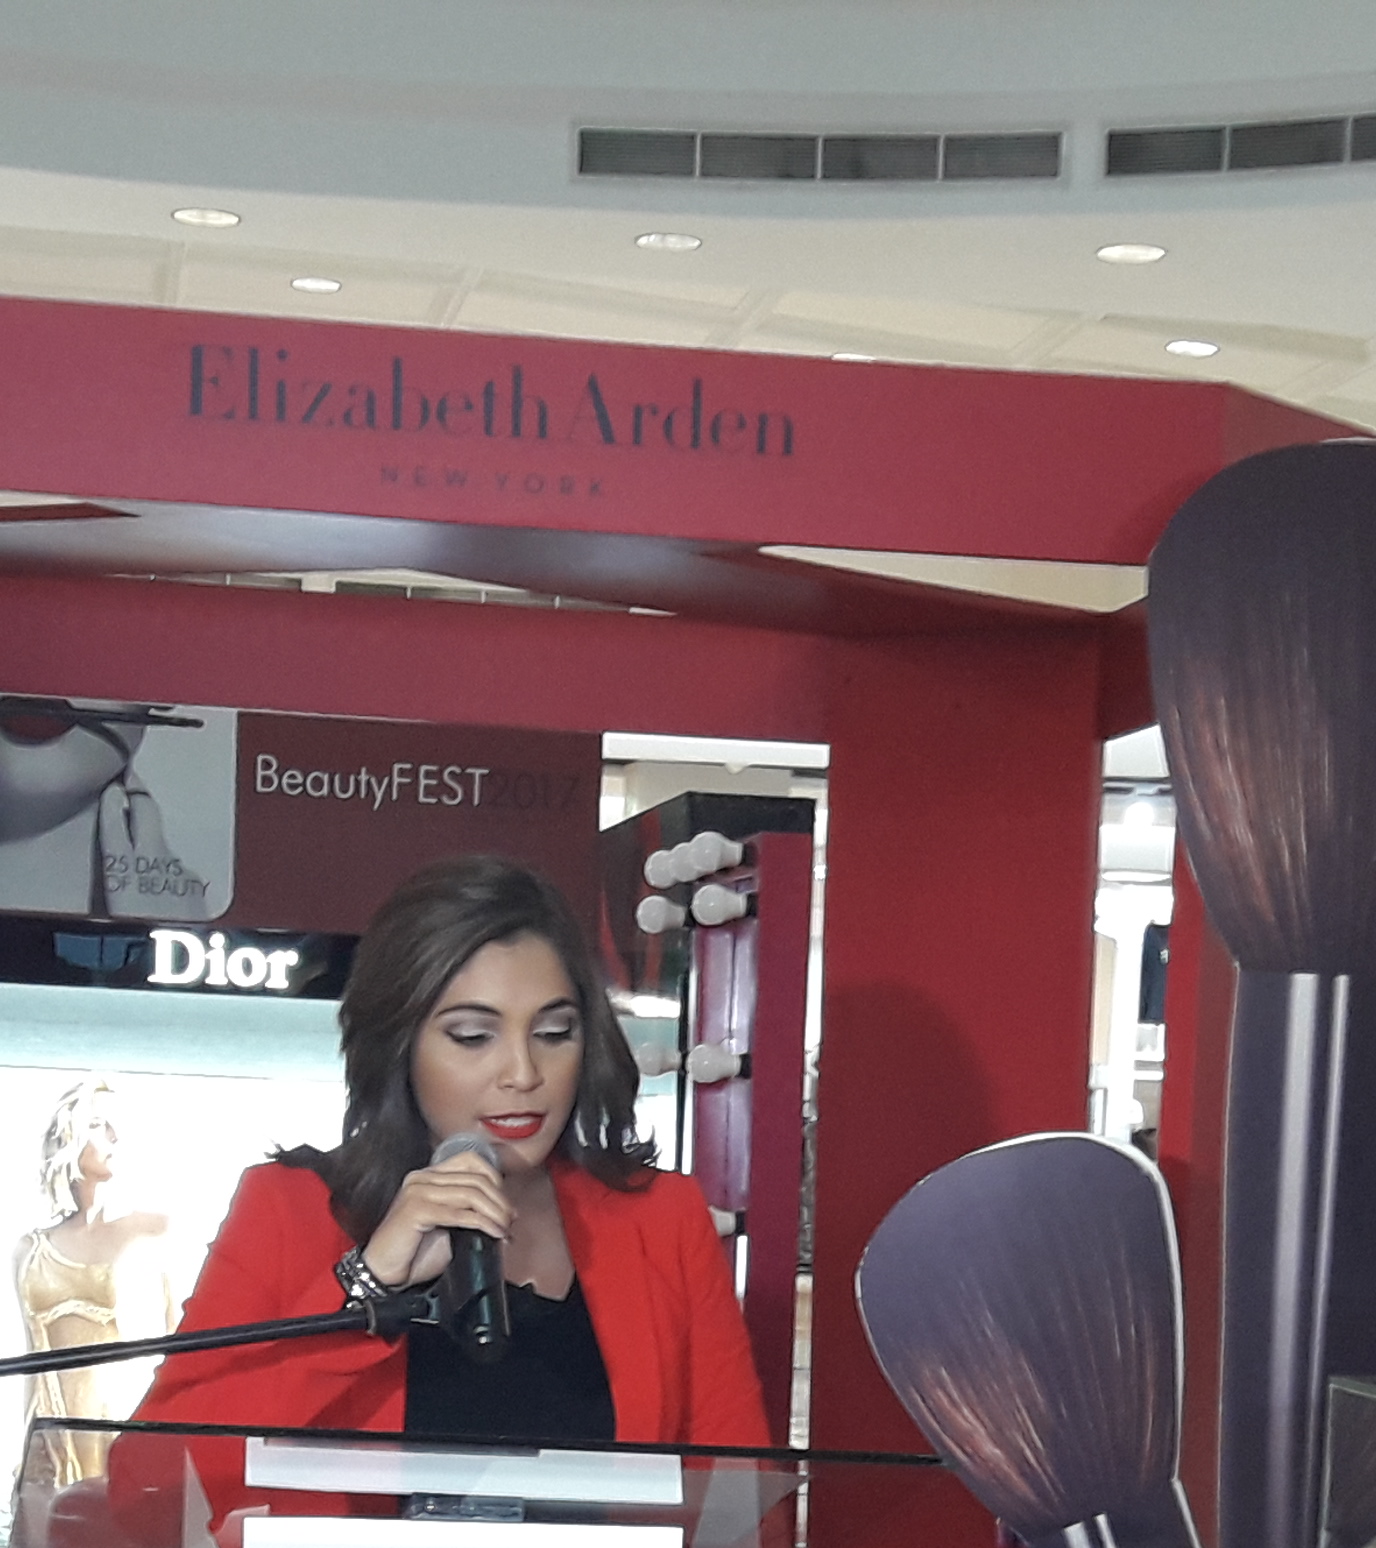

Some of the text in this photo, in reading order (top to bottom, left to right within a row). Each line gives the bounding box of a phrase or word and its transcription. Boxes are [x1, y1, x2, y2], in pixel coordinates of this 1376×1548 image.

[186, 342, 796, 457] Elizabeth Arden
[380, 461, 604, 497] NEW YORK
[104, 854, 185, 877] 25 DAYS
[104, 874, 211, 898] OF BEAUTY
[147, 929, 300, 990] Dior
